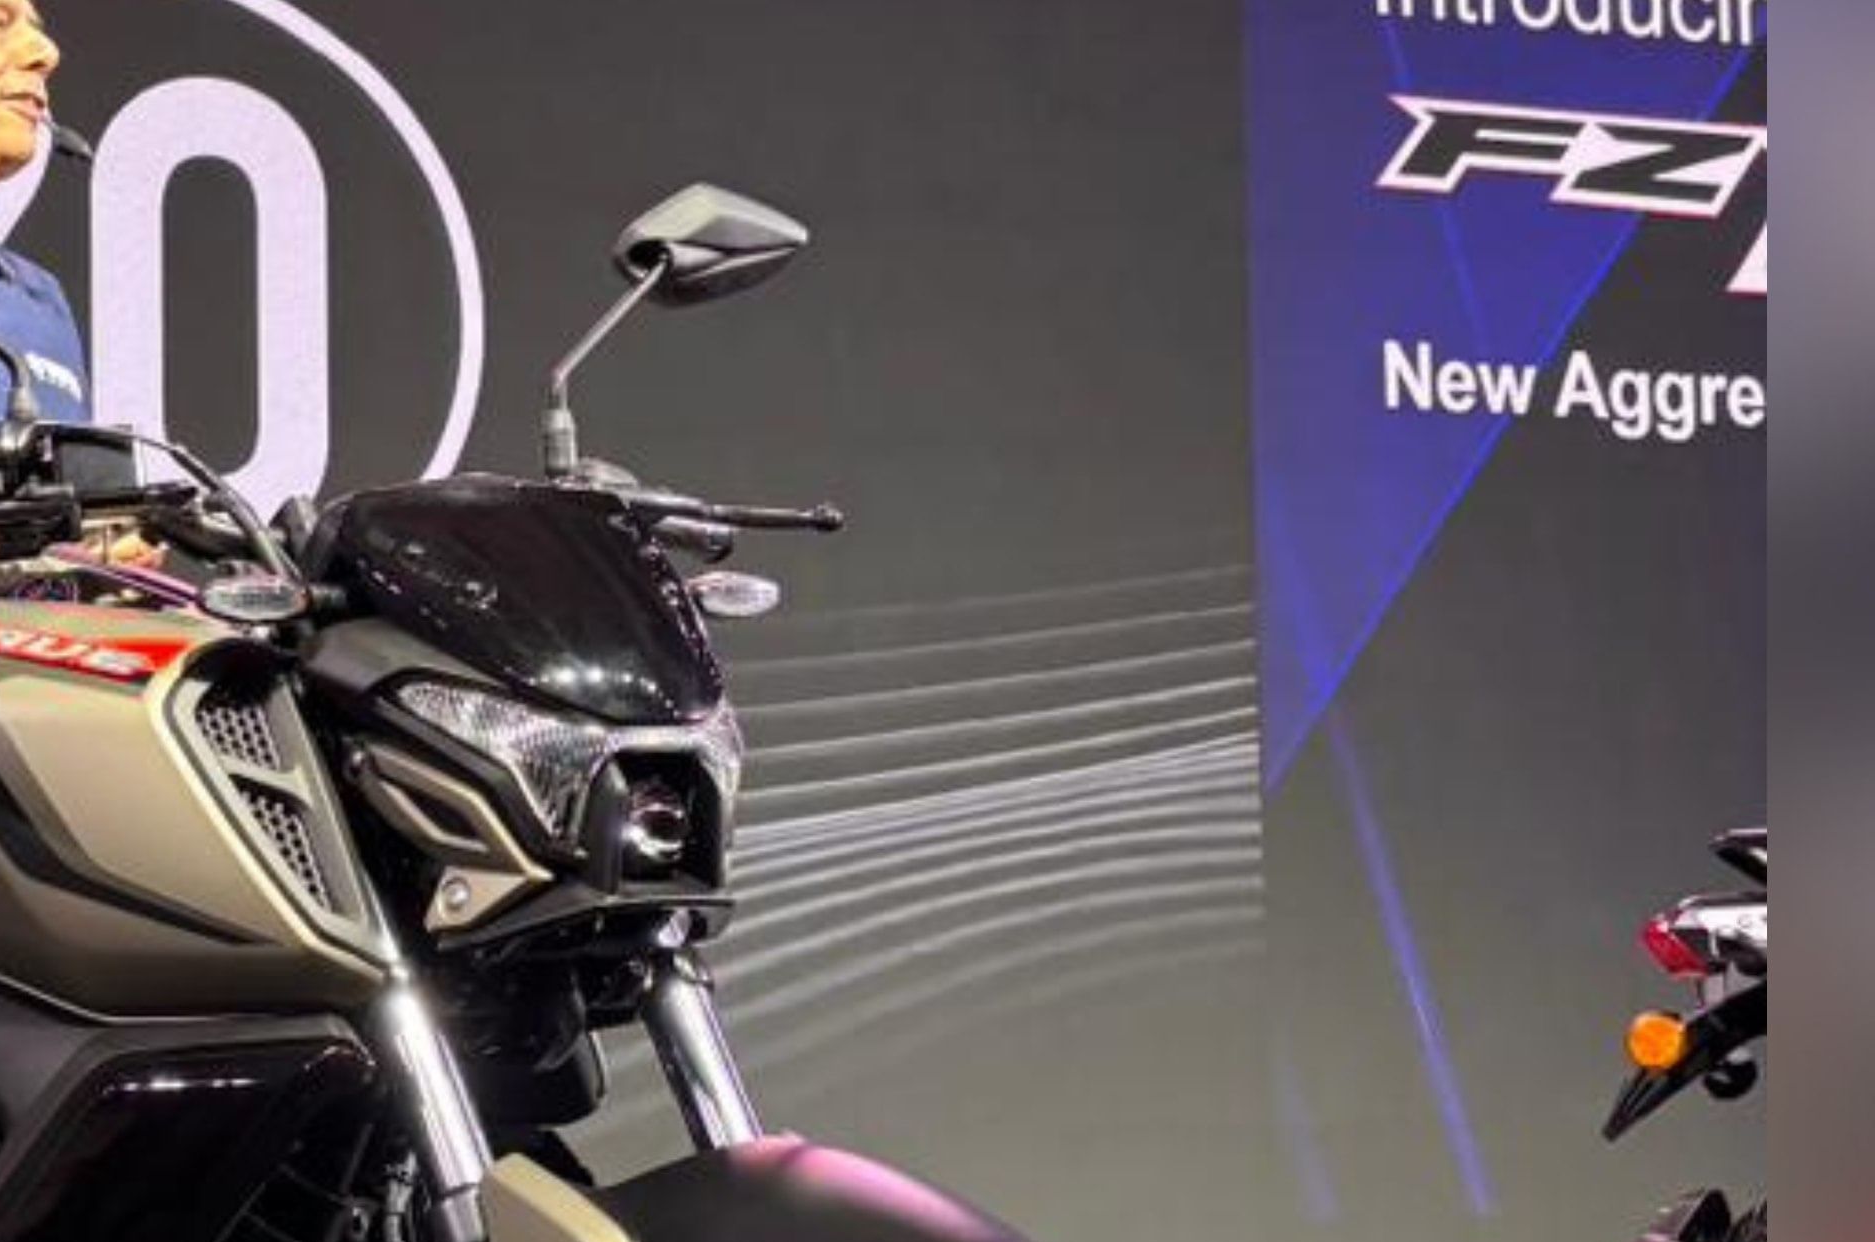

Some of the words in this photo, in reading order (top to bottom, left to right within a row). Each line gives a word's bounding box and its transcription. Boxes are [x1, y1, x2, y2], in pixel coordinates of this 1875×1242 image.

[1377, 0, 1753, 45] oduci
[1383, 340, 1537, 415] New
[1554, 350, 1766, 441] Aggre
